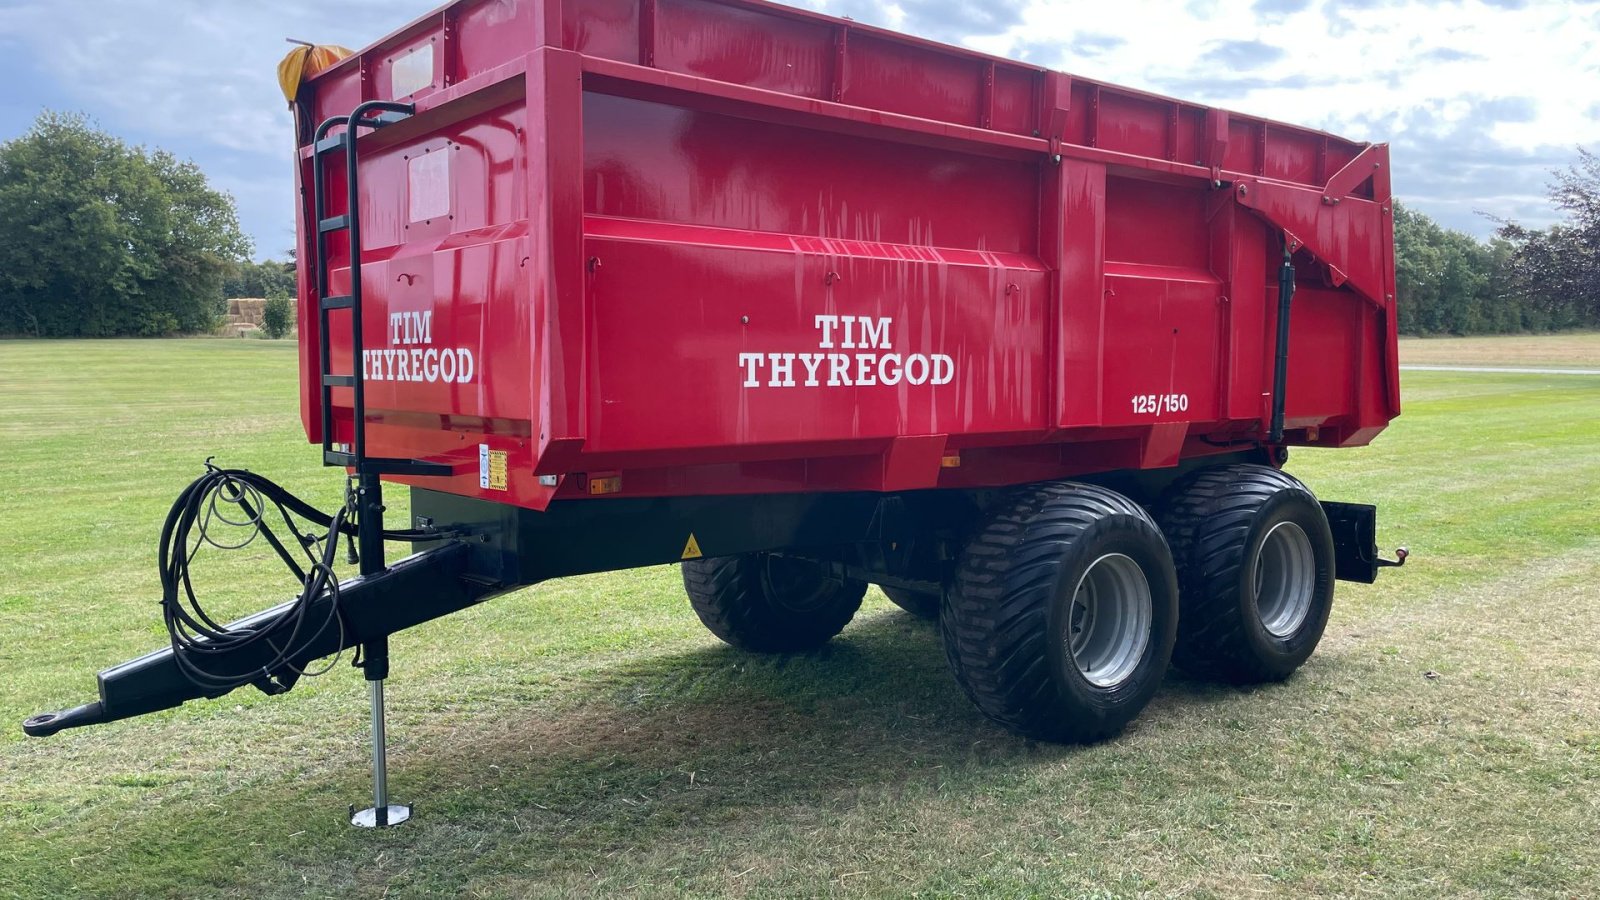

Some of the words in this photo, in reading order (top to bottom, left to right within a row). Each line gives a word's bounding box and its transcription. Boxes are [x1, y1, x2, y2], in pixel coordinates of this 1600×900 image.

[391, 310, 432, 345] TIM
[815, 315, 892, 350] TIM
[739, 353, 954, 387] THYREGOD
[1131, 394, 1188, 416] 125/150
